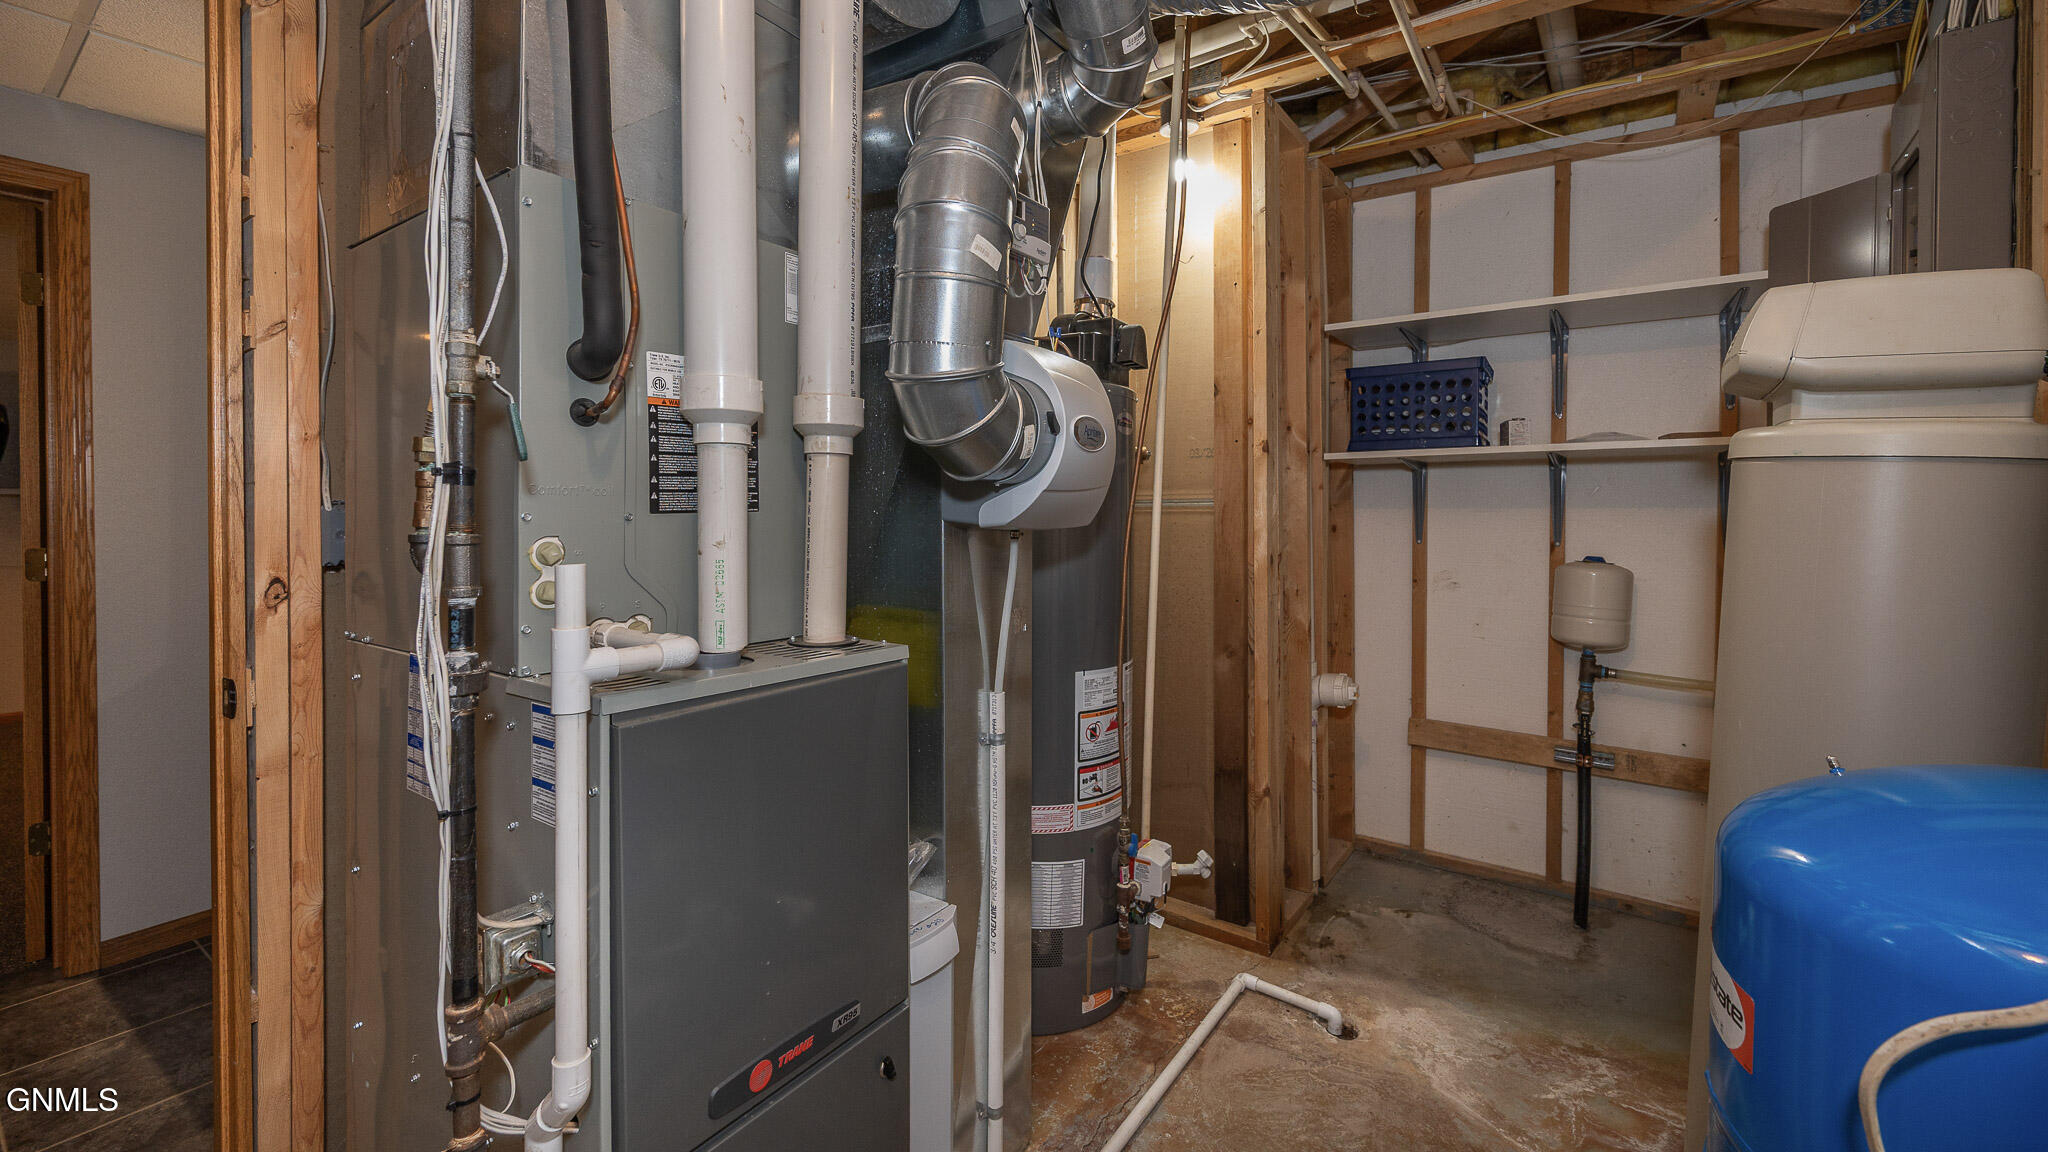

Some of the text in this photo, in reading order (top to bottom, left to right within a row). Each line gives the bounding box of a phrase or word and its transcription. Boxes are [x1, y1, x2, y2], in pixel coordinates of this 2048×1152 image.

[715, 591, 725, 614] ASTM
[990, 877, 998, 891] SCH
[837, 1006, 859, 1029] XR95
[778, 1034, 815, 1068] TRANE
